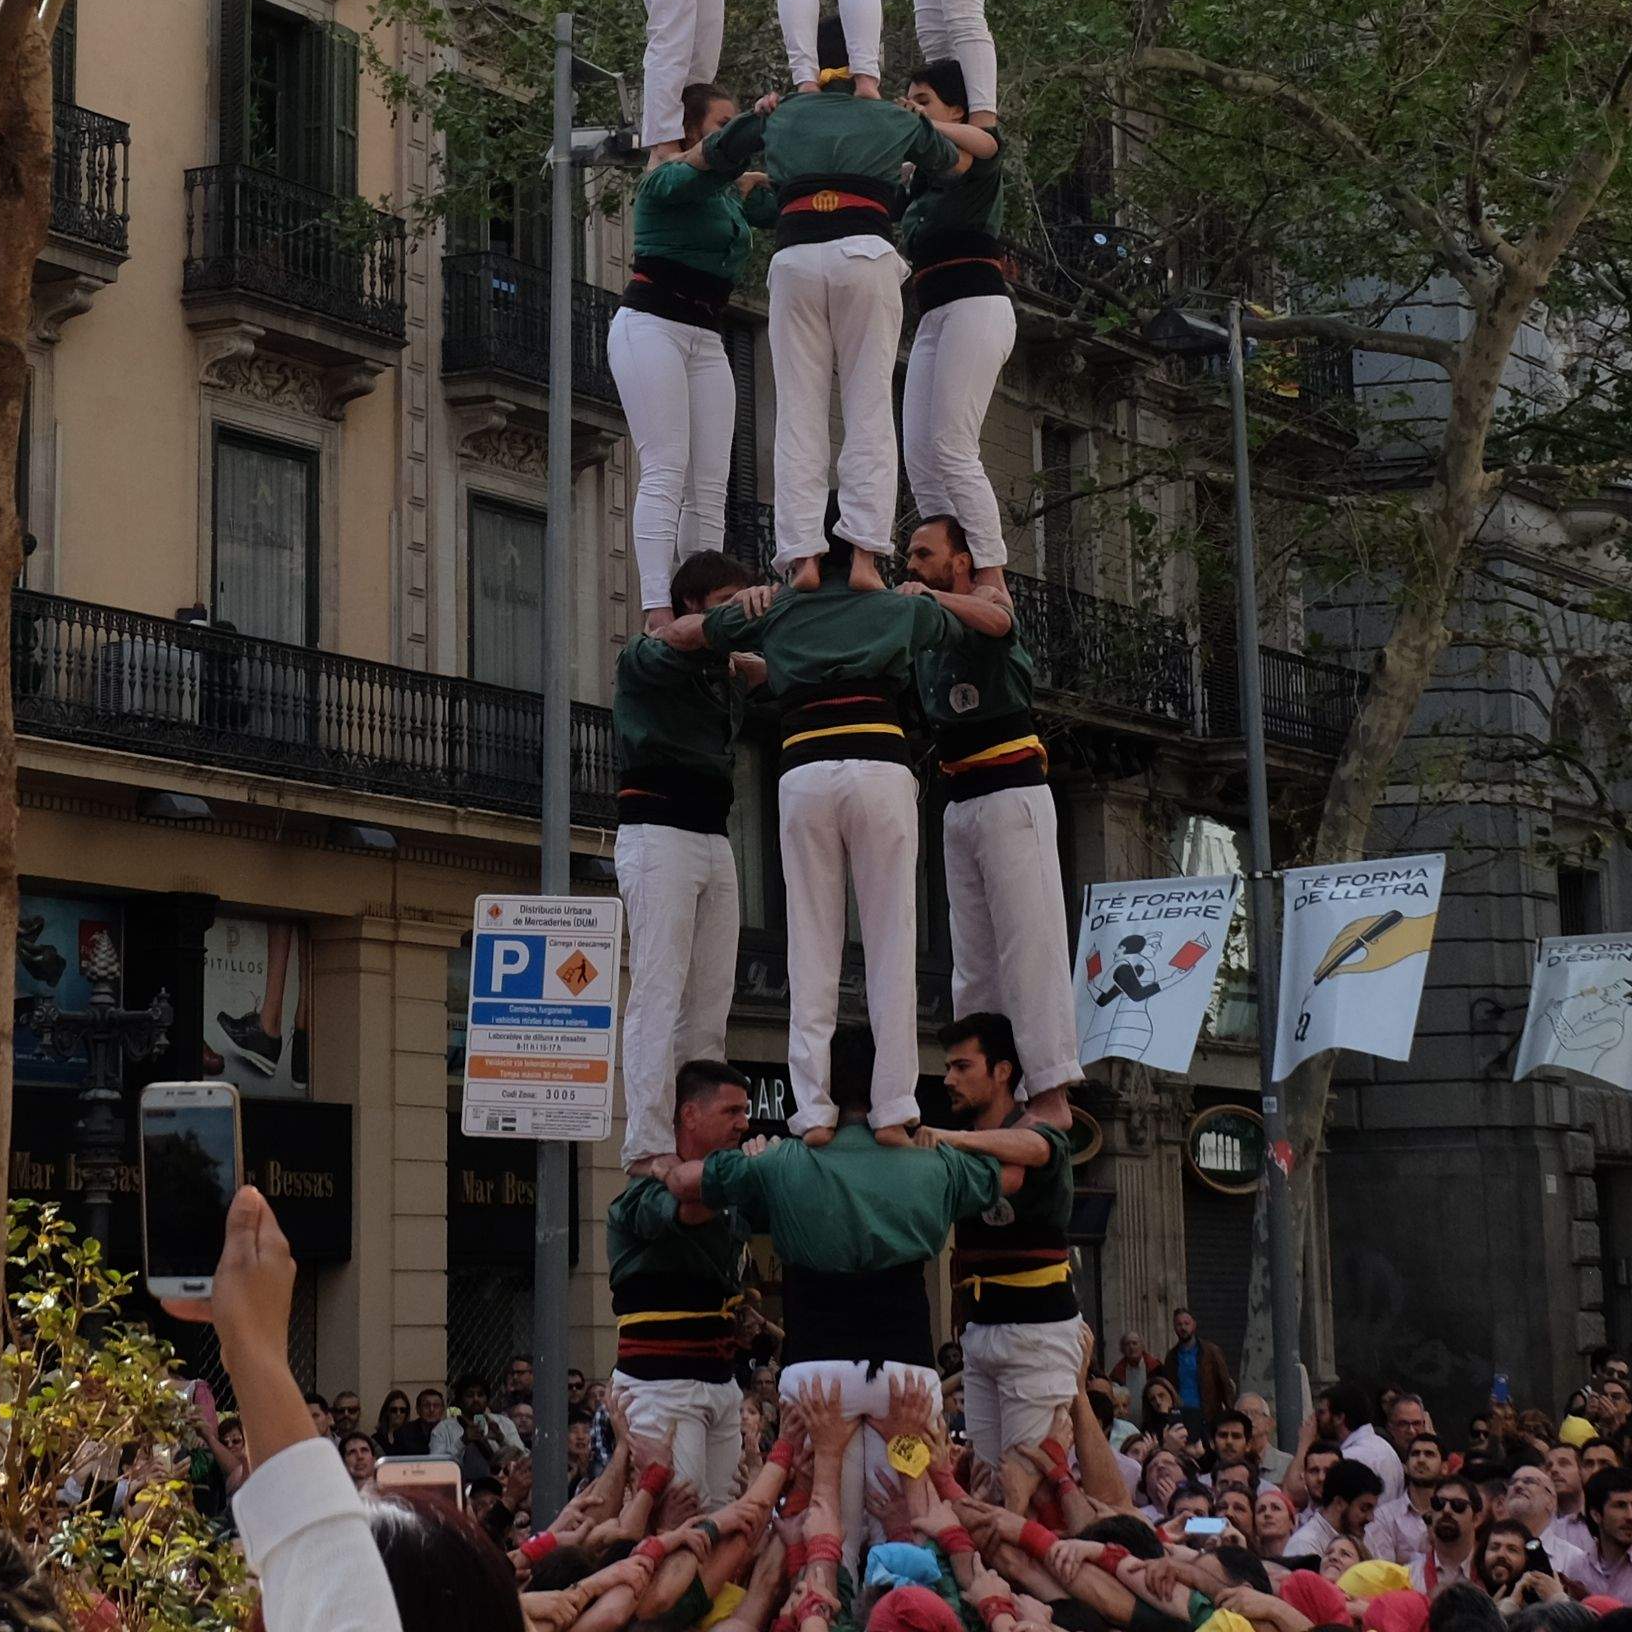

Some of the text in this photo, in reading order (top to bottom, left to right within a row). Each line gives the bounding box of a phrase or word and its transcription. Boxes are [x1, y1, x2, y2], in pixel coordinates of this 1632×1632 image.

[1300, 868, 1430, 891] TÉ FORMA
[564, 905, 593, 916] Urbana
[1094, 887, 1226, 910] TÉ FORMA
[1293, 882, 1429, 911] DE LLETRA
[512, 916, 524, 926] de
[573, 918, 598, 929] (DUM)
[1090, 905, 1222, 932] DE LLIBRE
[490, 939, 530, 993] P
[13, 1151, 55, 1191] Mar
[264, 1159, 335, 1200] Bessas
[462, 1169, 495, 1206] Mar
